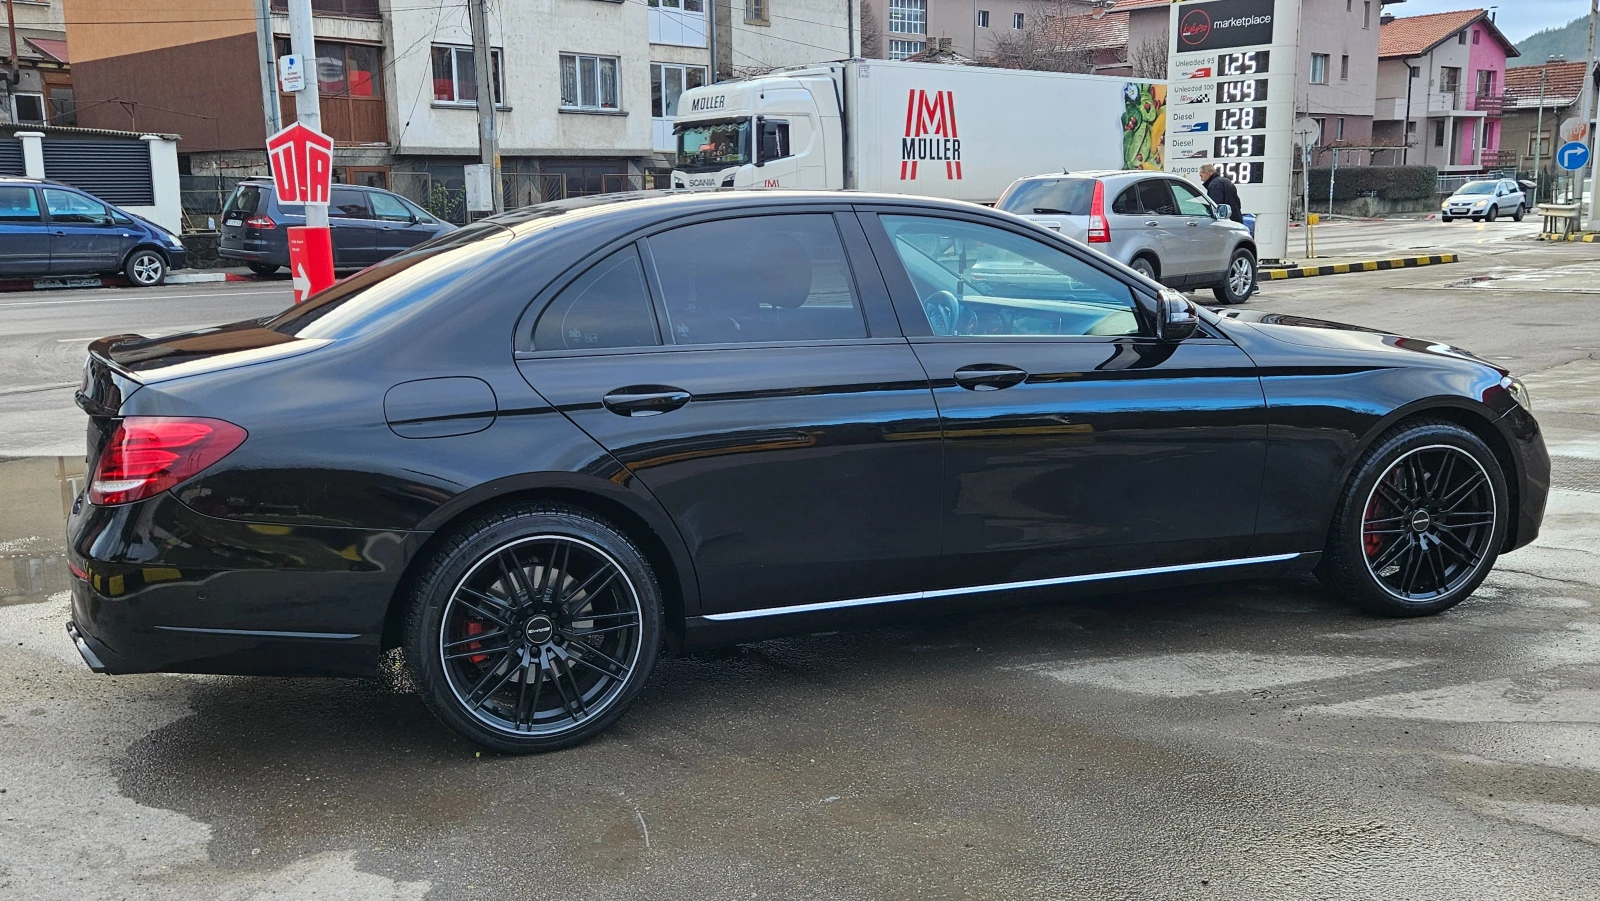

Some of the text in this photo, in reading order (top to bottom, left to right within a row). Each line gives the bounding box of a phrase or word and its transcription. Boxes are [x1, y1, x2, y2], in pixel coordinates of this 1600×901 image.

[1213, 14, 1272, 29] marketplace
[1175, 58, 1205, 67] Unleaded
[1173, 112, 1195, 121] Diesel
[1172, 139, 1194, 147] Diesel
[902, 137, 961, 161] MÜLLER
[1172, 166, 1198, 175] Autogas
[689, 178, 716, 187] SCANIA
